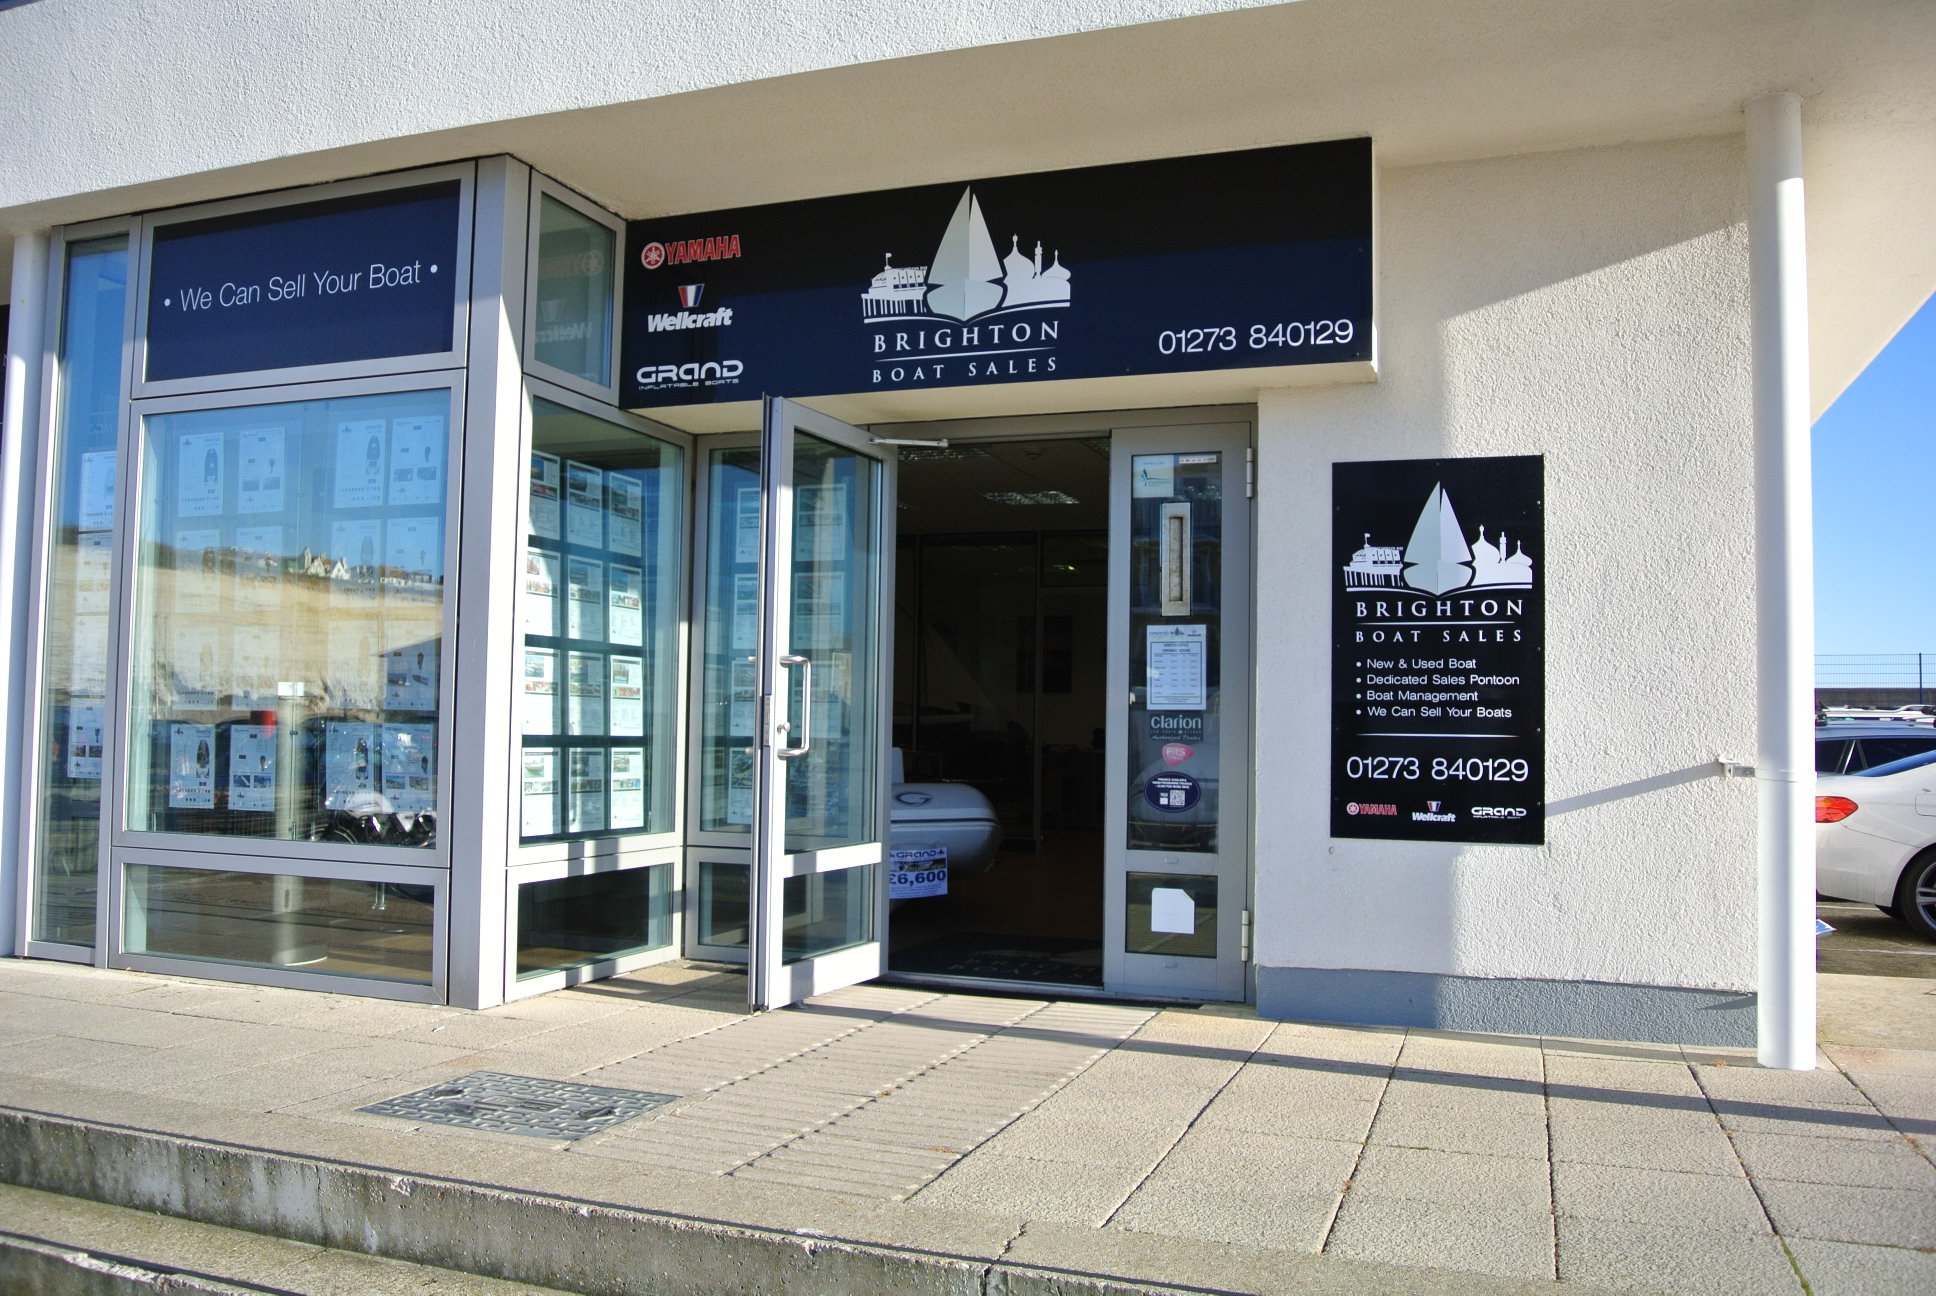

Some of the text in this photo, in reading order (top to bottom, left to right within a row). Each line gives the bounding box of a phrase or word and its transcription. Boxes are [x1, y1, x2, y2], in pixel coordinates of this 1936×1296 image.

[665, 234, 741, 265] YAMAHA
[180, 260, 421, 312] We Can Sell Your Boat
[647, 306, 733, 333] Wellcraft
[873, 320, 1059, 353] BRIGHTON
[1158, 318, 1354, 355] 01273 840129
[636, 359, 744, 384] GRAND
[872, 356, 1056, 383] BOAT SALES
[1356, 599, 1523, 617] BRIGHTON
[1355, 629, 1521, 643] BOAT SALES
[1366, 658, 1477, 669] New & Used Boat
[1366, 674, 1520, 686] Dedicated Sales Pontoon
[1366, 690, 1479, 703] Boat Management
[1150, 714, 1202, 729] Clarion
[1367, 706, 1513, 718] We Can Sell Your Boats
[1346, 756, 1529, 782] 01273 840129
[1359, 803, 1398, 816] YAMAHA
[1411, 812, 1457, 823] Wellcraft
